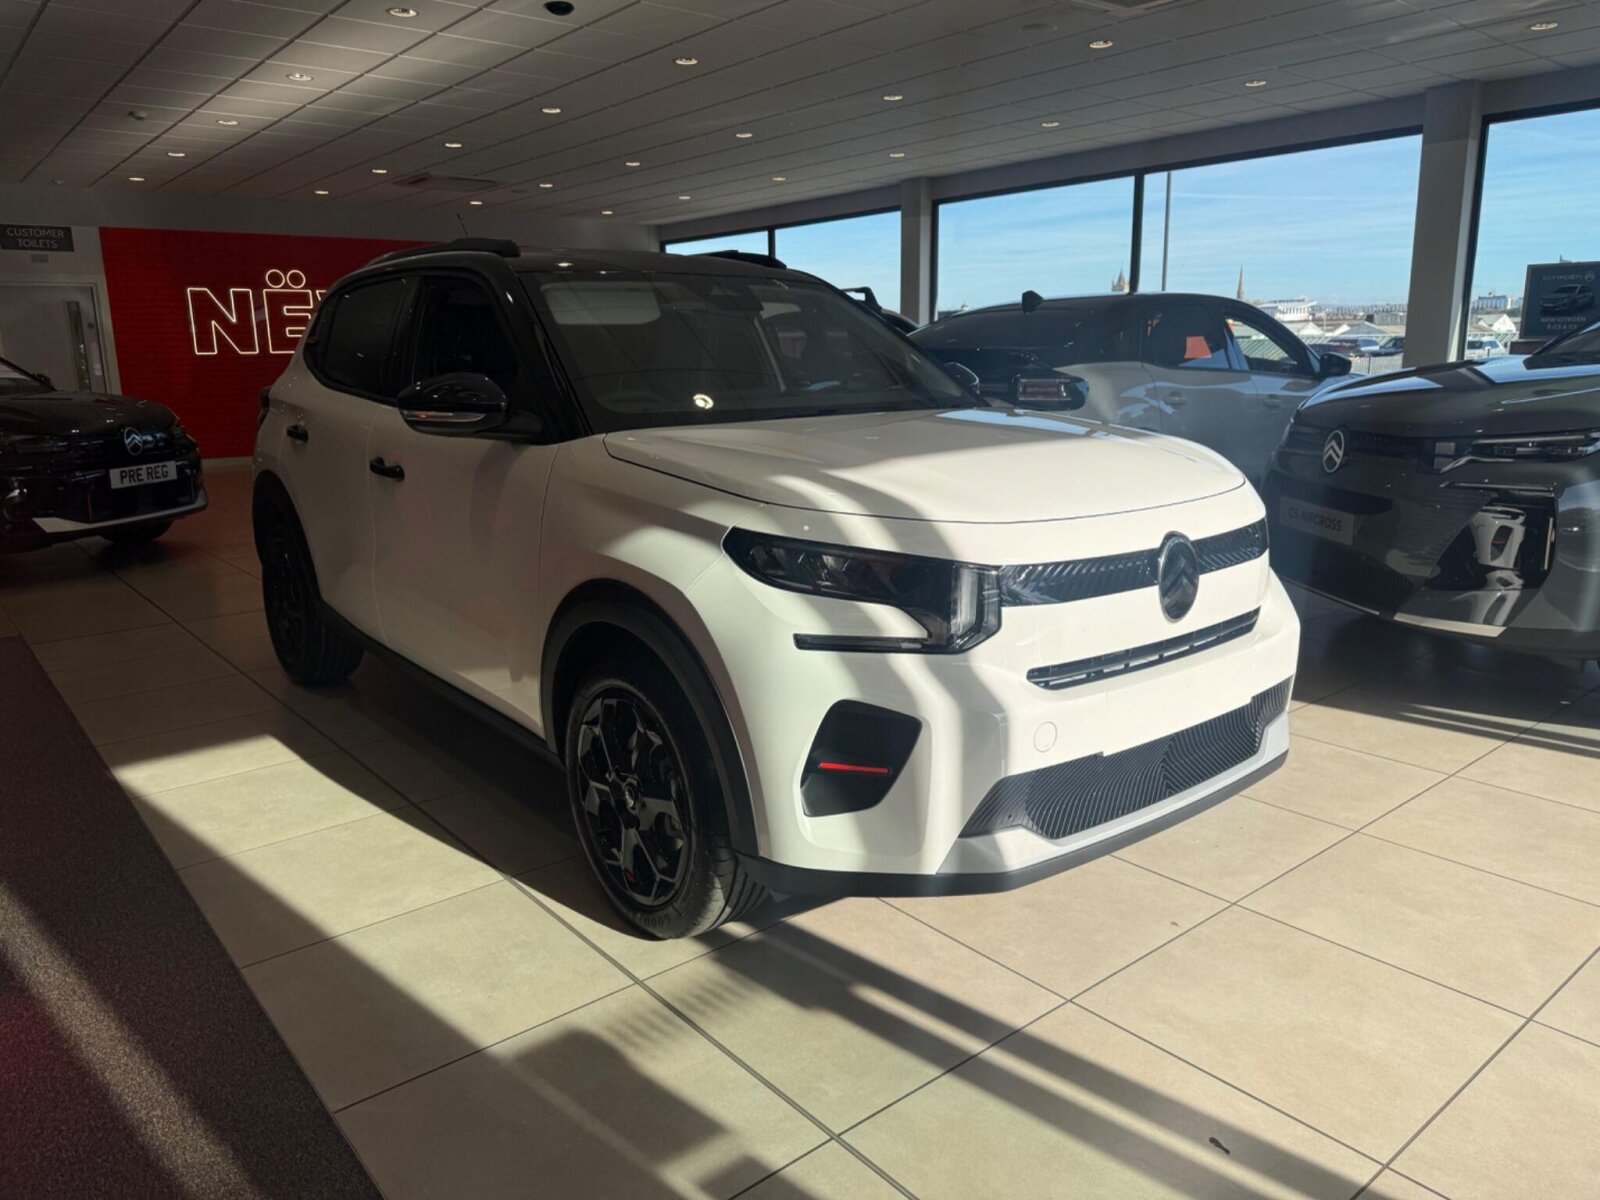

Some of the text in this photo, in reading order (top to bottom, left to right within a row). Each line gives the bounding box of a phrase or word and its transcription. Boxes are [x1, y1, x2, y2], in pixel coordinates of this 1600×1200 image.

[6, 227, 64, 238] CUSTOMER
[15, 238, 59, 249] TOILETS
[187, 268, 327, 355] NË
[120, 464, 169, 484] PRE REG
[1301, 510, 1342, 531] AIRCROSS
